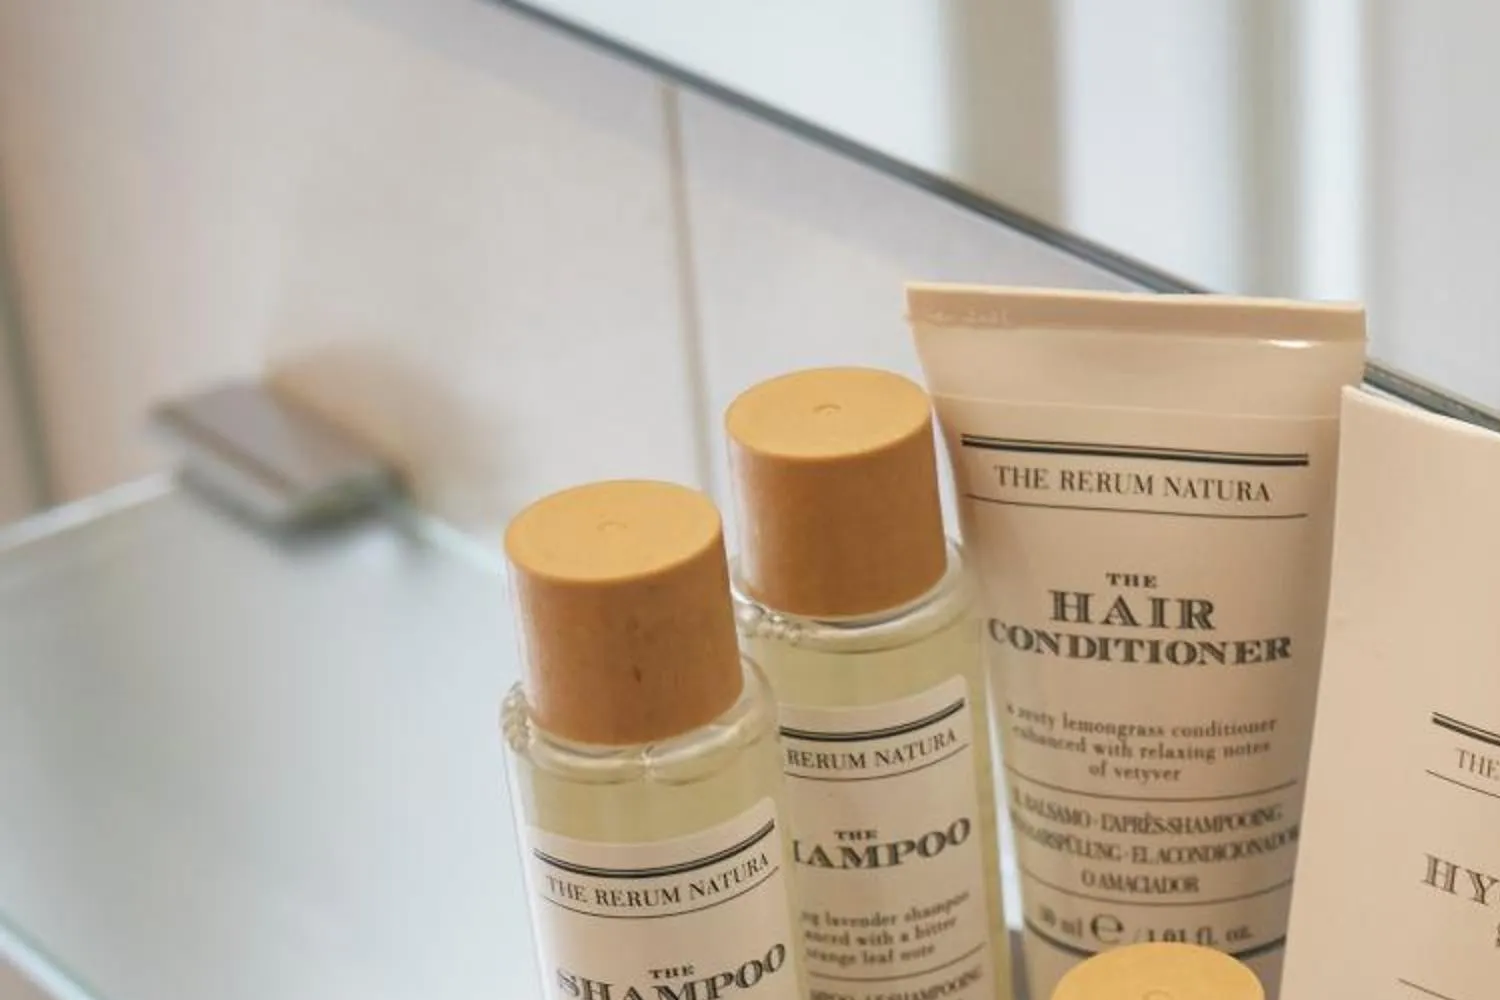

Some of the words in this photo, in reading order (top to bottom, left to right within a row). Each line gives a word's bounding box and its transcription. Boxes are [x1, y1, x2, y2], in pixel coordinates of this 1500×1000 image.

[994, 464, 1050, 492] THE
[1060, 470, 1155, 497] RERUM
[1163, 477, 1271, 503] NATURA
[1105, 572, 1159, 589] THE
[1048, 588, 1216, 631] HAIR
[987, 617, 1292, 667] CONDITIONER
[1061, 713, 1166, 741] lemongrass
[1171, 717, 1278, 739] conditioner
[786, 747, 867, 770] RERUM
[875, 727, 956, 762] NATURA
[1092, 738, 1133, 759] with
[1139, 743, 1216, 764] relaxing
[1223, 740, 1271, 758] notes
[1088, 761, 1108, 779] of
[1113, 765, 1183, 784] vetyver
[1456, 747, 1500, 782] THE
[834, 828, 879, 841] THE
[1131, 846, 1150, 865] EL
[546, 874, 588, 903] THE
[595, 886, 681, 908] RERUM
[689, 852, 770, 897] NATURA
[1081, 869, 1098, 887] O
[1099, 872, 1200, 895] AMACIADOR
[856, 928, 894, 946] with
[863, 947, 893, 965] leaf
[648, 964, 696, 980] THE
